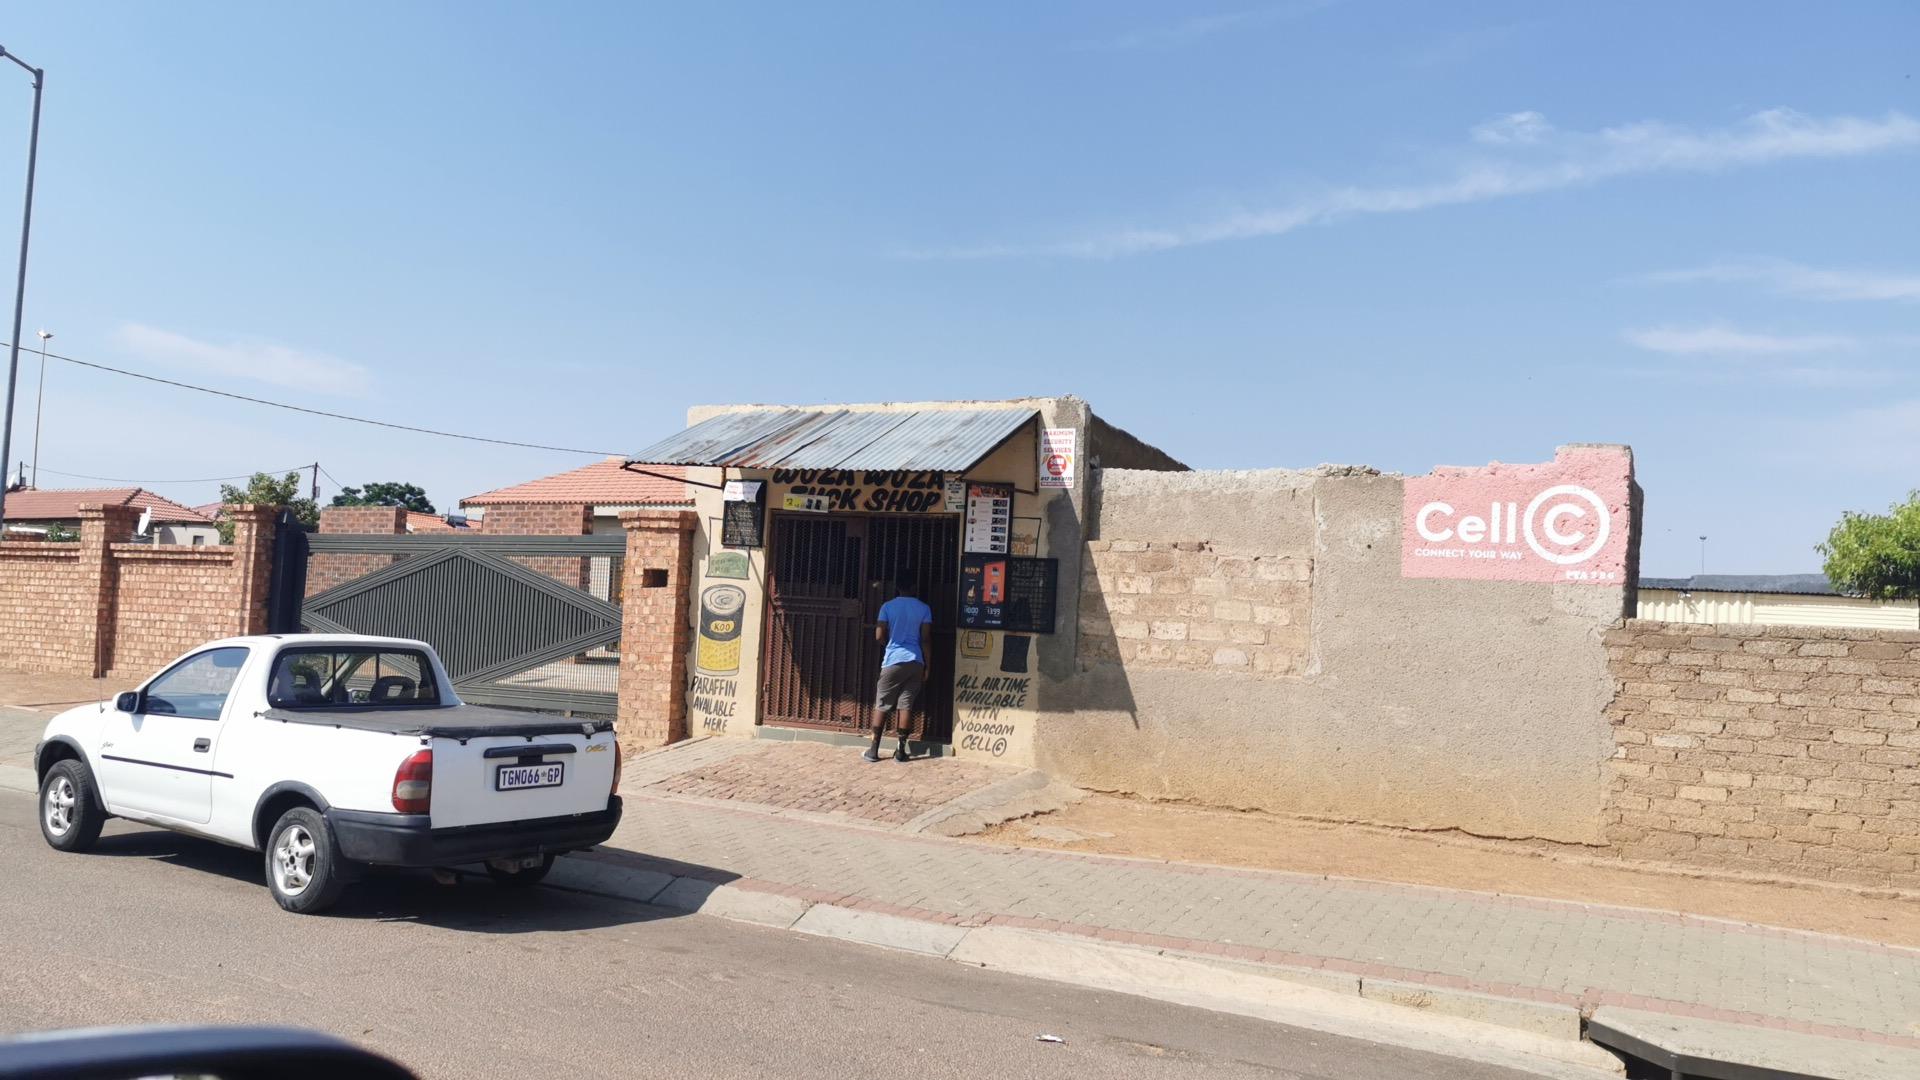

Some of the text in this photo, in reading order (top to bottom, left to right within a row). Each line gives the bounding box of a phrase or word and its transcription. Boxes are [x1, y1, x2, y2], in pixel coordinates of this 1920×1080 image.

[863, 487, 941, 512] SHOP
[1415, 501, 1518, 544] Cell
[1414, 548, 1523, 560] CONNECT YOUR WAY
[713, 622, 731, 632] KOO
[690, 675, 738, 698] PARAFFIN
[956, 674, 1031, 693] ALL AIRTIME
[693, 695, 737, 718] AVAILABLE
[955, 690, 1028, 708] AVAILABLE
[967, 706, 1001, 721] MTN
[703, 716, 728, 734] HERE
[960, 720, 1015, 736] VODACOM
[501, 766, 560, 786] TGN066 GP
